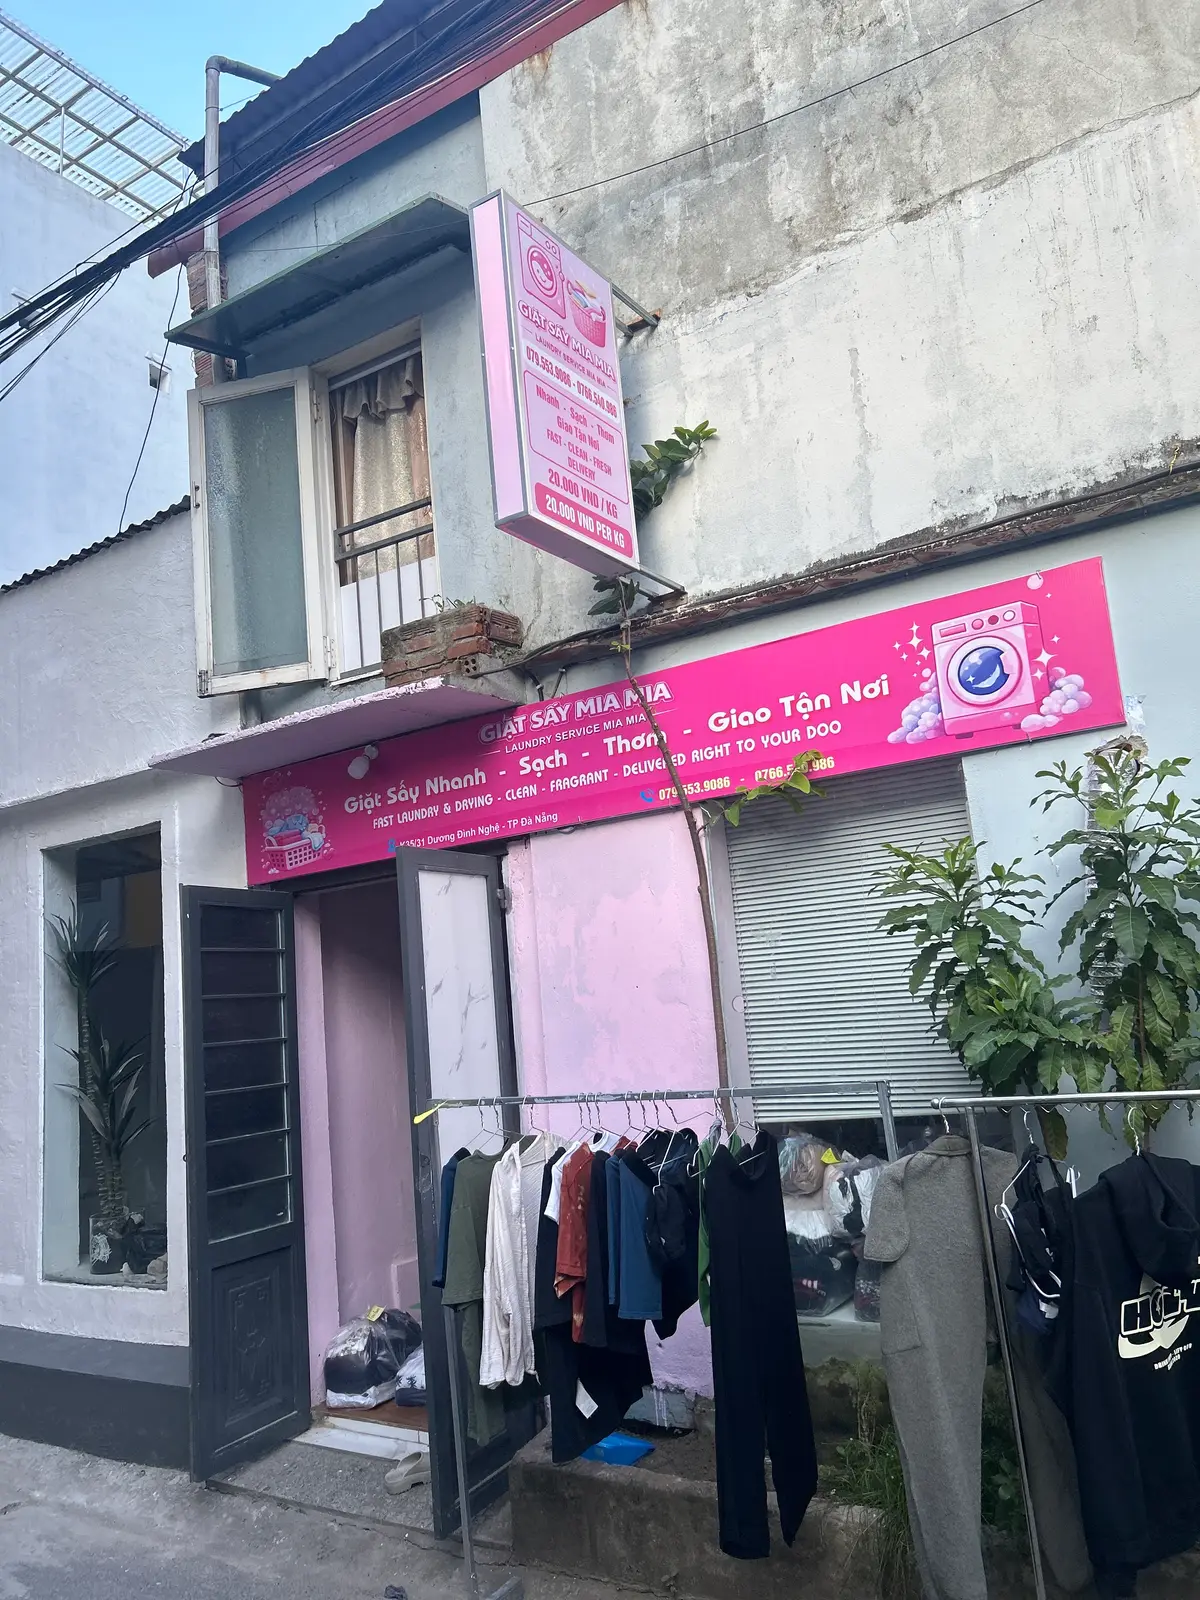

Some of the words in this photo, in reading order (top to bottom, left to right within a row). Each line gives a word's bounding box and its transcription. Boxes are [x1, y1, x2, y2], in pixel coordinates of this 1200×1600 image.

[526, 345, 572, 388] 079.553.9086
[535, 332, 562, 357] LAUNDRY
[563, 352, 586, 375] SERVICE
[586, 369, 596, 381] MIA
[597, 376, 607, 388] MIA
[572, 338, 594, 364] MIA
[594, 355, 617, 383] MIA
[536, 384, 560, 410] Nhanh
[569, 407, 587, 427] Sạch
[546, 428, 562, 448] FAST
[568, 441, 588, 462] CLEAN
[593, 456, 612, 477] FRESH
[556, 415, 573, 436] Giao
[574, 425, 587, 442] Tận
[588, 434, 600, 451] Nơi
[567, 456, 596, 482] DELIVERY
[548, 467, 579, 499] 20.000
[581, 487, 599, 510] VND
[606, 503, 618, 520] KG
[545, 493, 576, 521] 20.000
[577, 512, 595, 534] VND
[596, 523, 612, 541] PER
[613, 531, 625, 549] KG
[480, 714, 527, 742] GIẶT
[531, 702, 571, 729] SẤY
[576, 693, 621, 718] MIA
[625, 683, 672, 707] MIA
[505, 735, 552, 754] LAUNDRY
[555, 724, 601, 742] SERVICE
[603, 717, 623, 731] MIA
[626, 713, 647, 725] MIA
[344, 792, 382, 815] Giặt
[387, 779, 420, 804] Sấy
[425, 767, 487, 796] Nhanh
[519, 749, 568, 778] Sạch
[603, 730, 667, 756] Thơm
[708, 706, 772, 732] Giao
[779, 691, 832, 720] Tận
[840, 673, 890, 705] Nơi
[373, 814, 394, 829] FAST
[397, 804, 440, 824] LAUNDRY
[443, 802, 452, 815] &
[455, 793, 494, 812] DRYING
[505, 784, 538, 801] CLEAN
[549, 769, 609, 793] FRAGRANT
[691, 743, 731, 763] RIGHT
[736, 738, 756, 753] TO
[761, 728, 801, 748] YOUR
[806, 720, 842, 740] DOO
[658, 776, 731, 801] 079553.9086
[457, 827, 476, 839] Đình
[478, 822, 500, 836] Nghệ
[507, 820, 519, 831] TP
[521, 815, 532, 826] Đà
